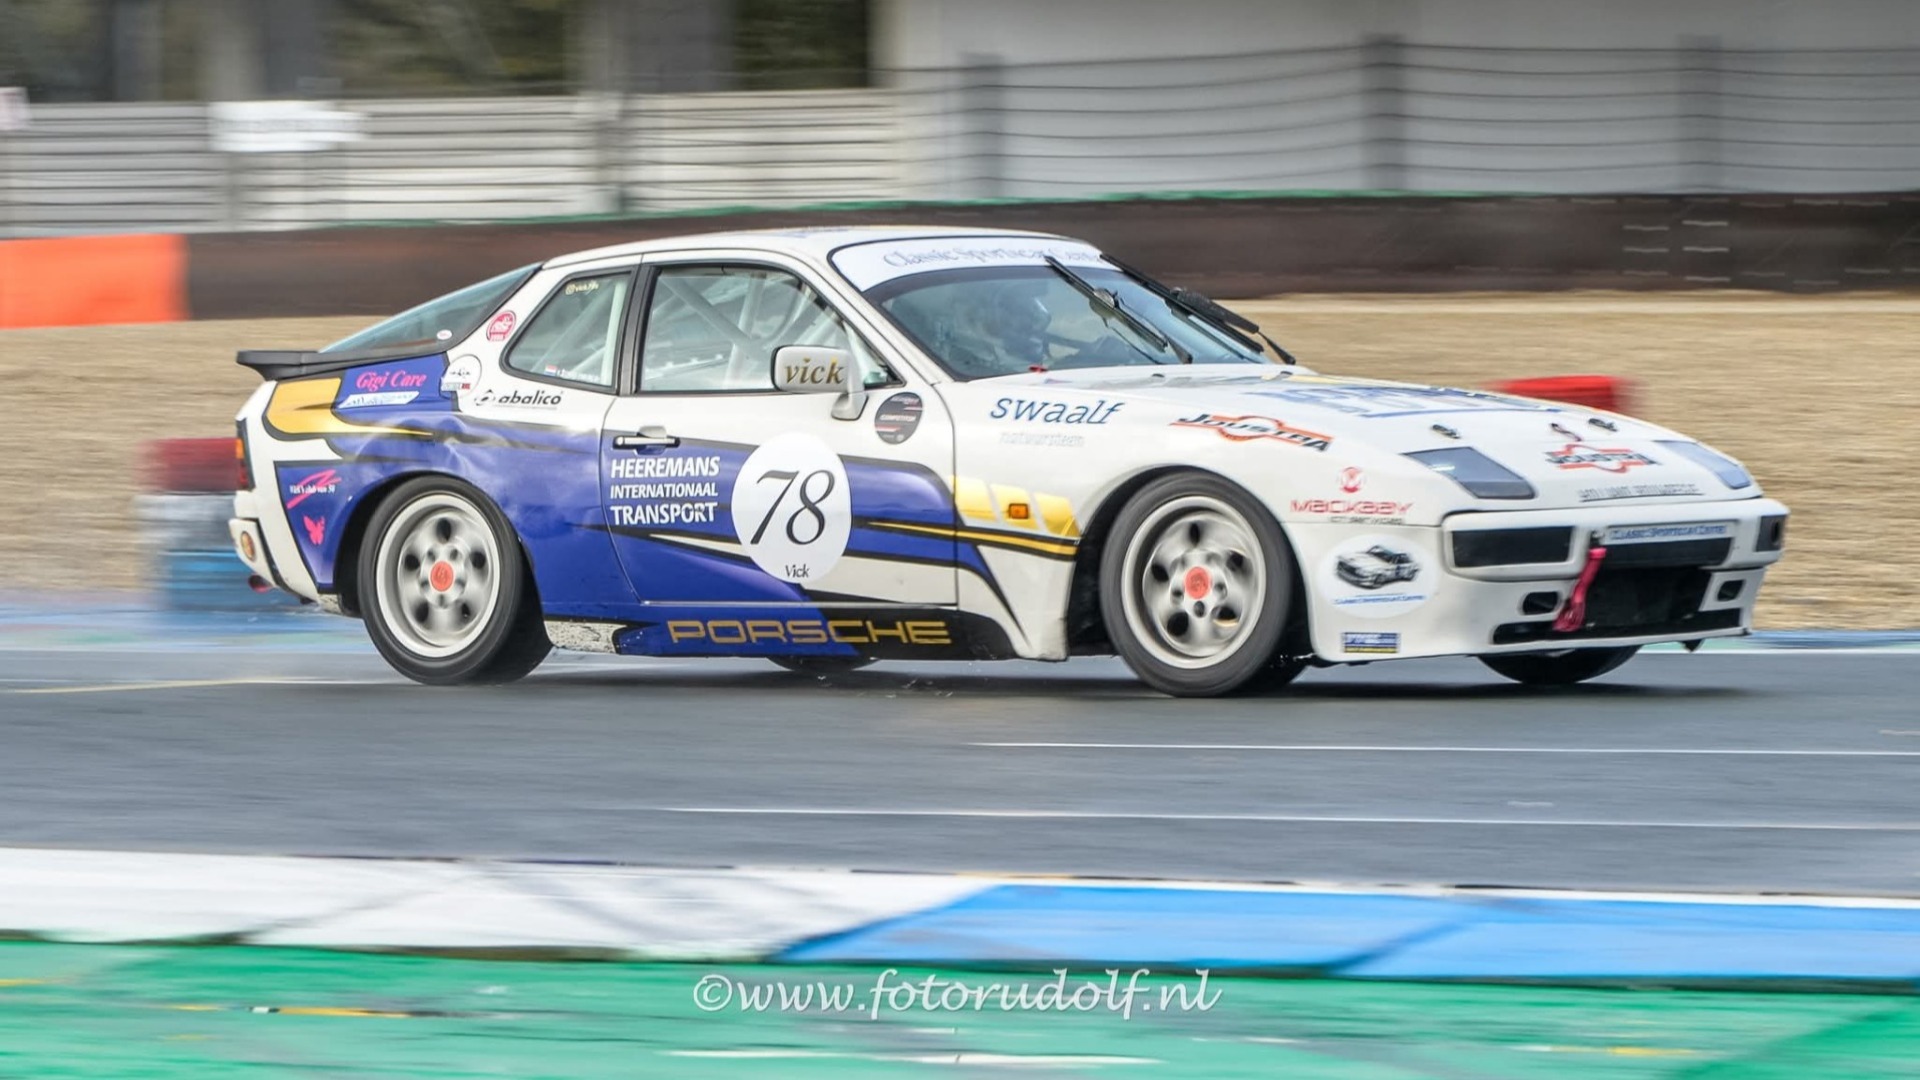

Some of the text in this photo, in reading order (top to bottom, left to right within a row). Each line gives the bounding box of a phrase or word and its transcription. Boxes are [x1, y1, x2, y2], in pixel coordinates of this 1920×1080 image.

[355, 371, 390, 393] Gigi
[390, 369, 427, 387] Care
[784, 357, 848, 386] vick
[498, 389, 562, 405] abalico
[989, 397, 1126, 425] swaalf
[610, 456, 721, 479] HEEREMANS
[610, 482, 719, 500] INTERNATIONAAL
[609, 501, 719, 526] TRANSPORT
[750, 468, 836, 546] 78
[784, 563, 810, 580] Vick
[667, 620, 953, 645] PORSCHE
